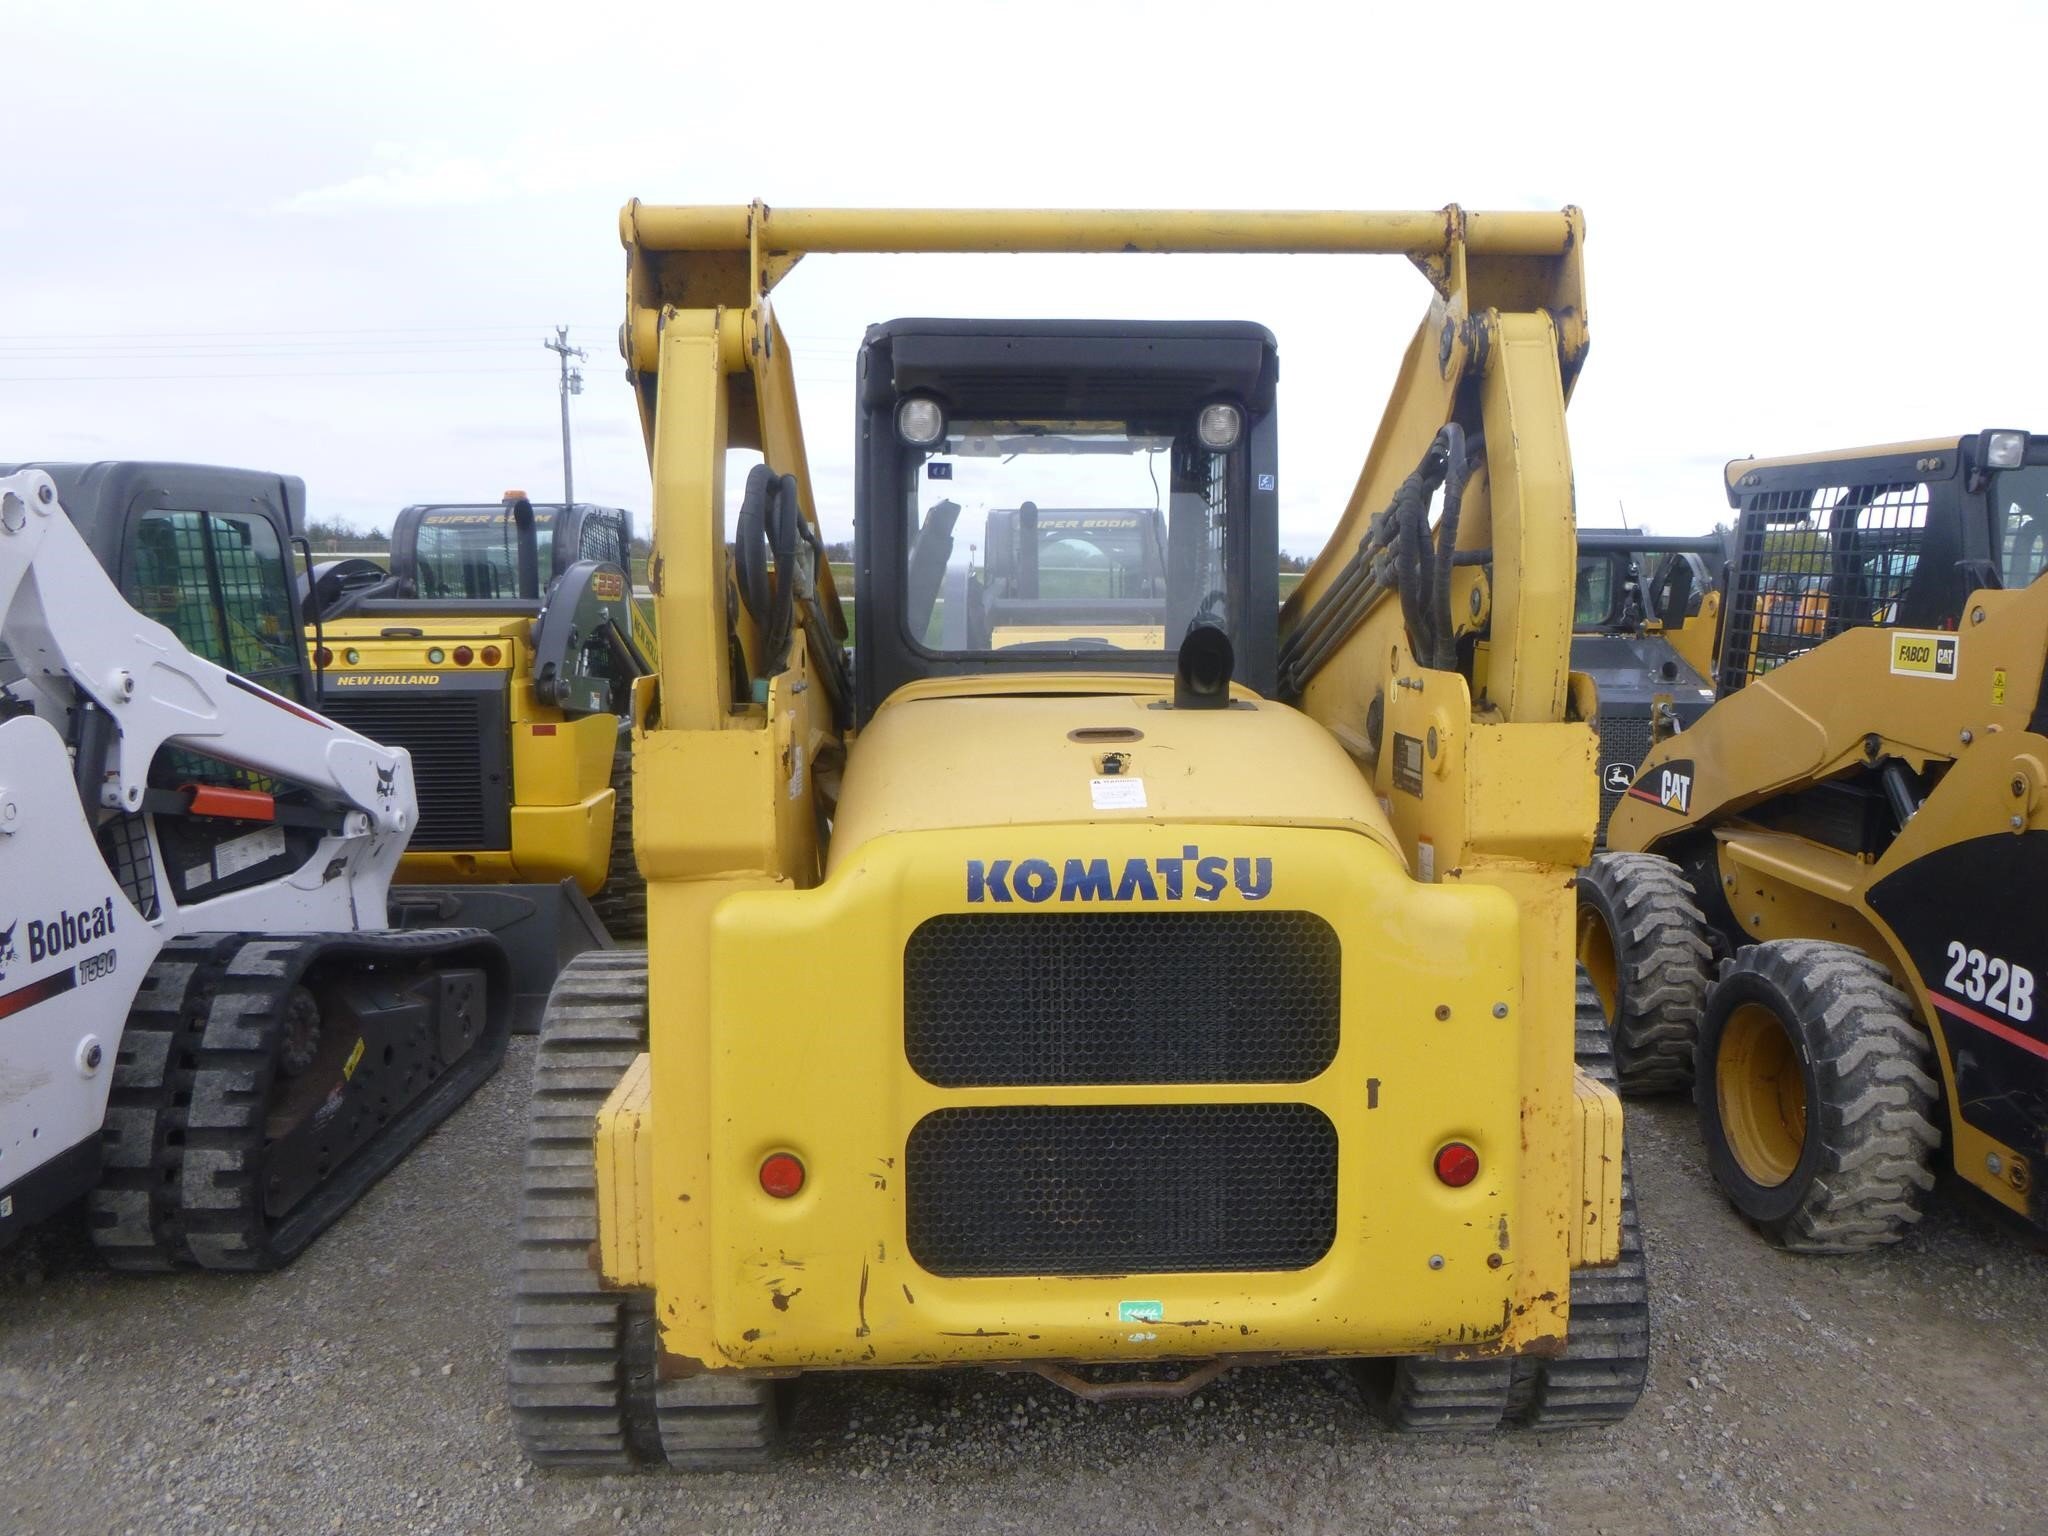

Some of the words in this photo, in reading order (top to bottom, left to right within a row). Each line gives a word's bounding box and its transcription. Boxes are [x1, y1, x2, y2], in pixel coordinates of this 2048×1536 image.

[424, 514, 490, 524] SUPER
[1082, 519, 1137, 528] BOOM
[1899, 645, 1930, 663] FABCO
[1937, 648, 1954, 665] CAT
[337, 676, 371, 686] NEW
[372, 675, 440, 685] HOLLAND
[1661, 769, 1691, 812] CAT
[967, 845, 1273, 903] KOMATSU
[27, 896, 115, 964] Bobcat
[79, 948, 117, 986] T590
[1944, 940, 2035, 1022] 232B
